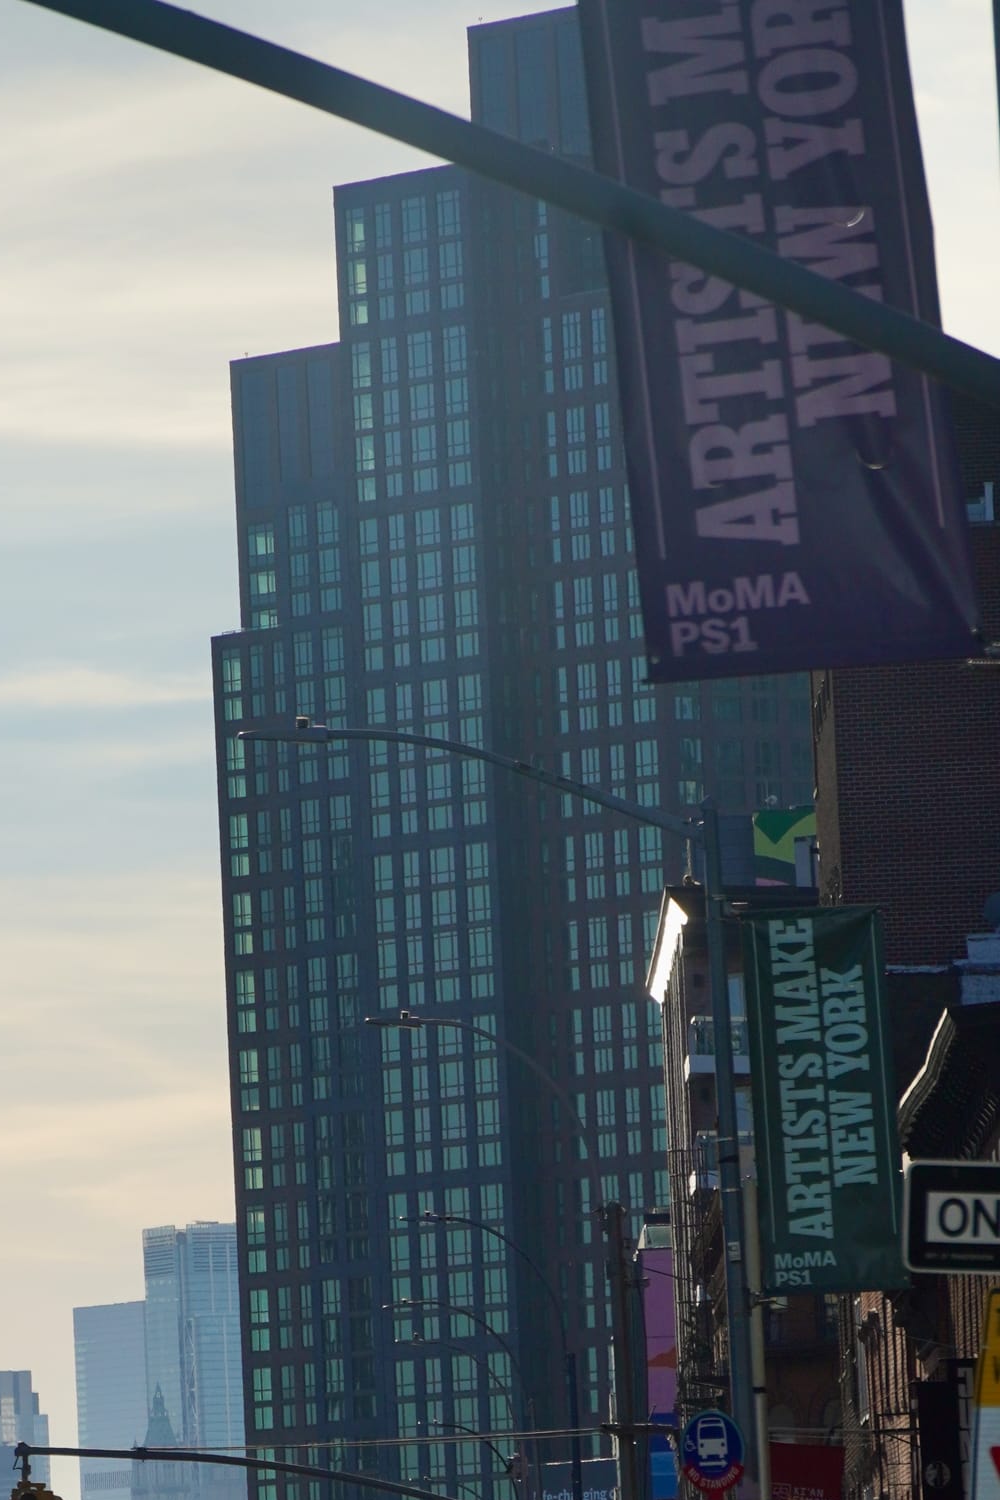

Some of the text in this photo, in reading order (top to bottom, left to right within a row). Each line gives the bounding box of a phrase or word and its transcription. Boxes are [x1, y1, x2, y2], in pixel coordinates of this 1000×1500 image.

[665, 571, 811, 618] MoMA
[670, 616, 759, 657] PS1
[768, 918, 835, 1240] ARTISTS MAKE
[821, 964, 878, 1189] NEW YORK
[774, 1249, 838, 1271] MoMA
[775, 1269, 813, 1288] PS1
[687, 1466, 740, 1489] NO STANDING
